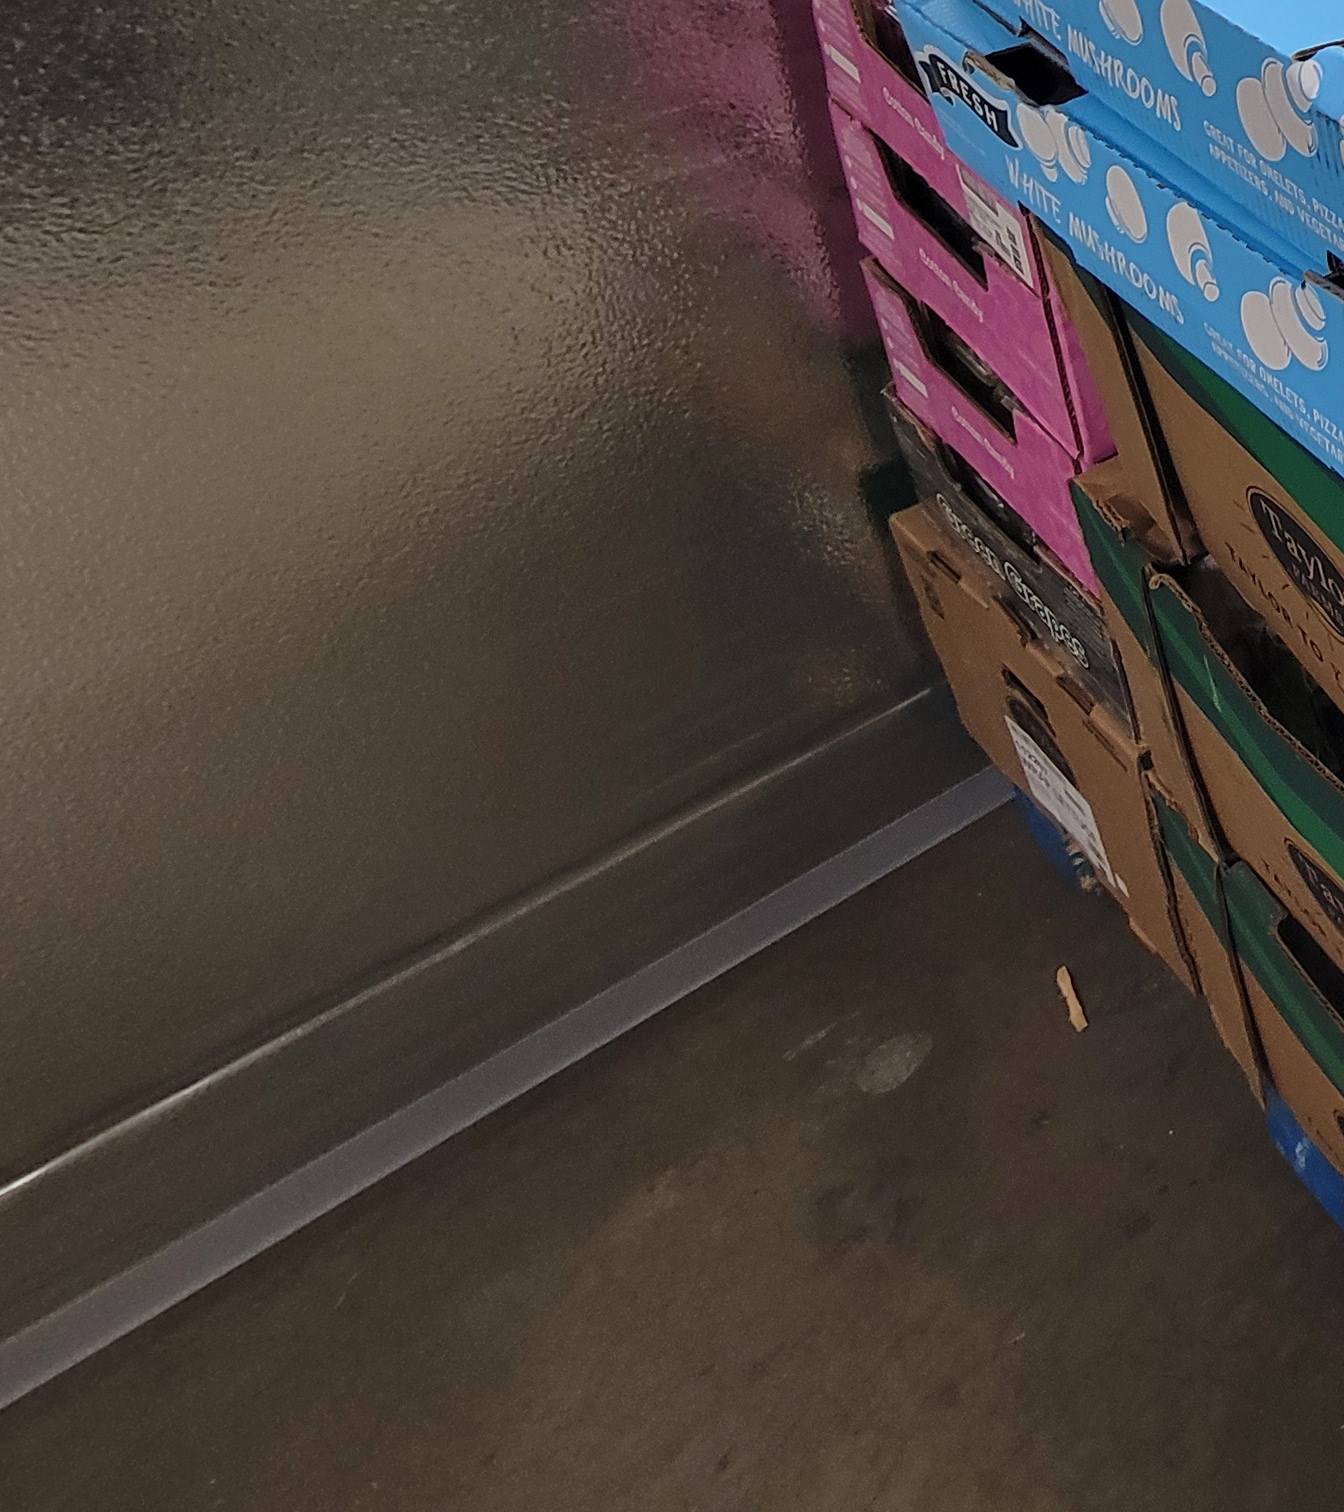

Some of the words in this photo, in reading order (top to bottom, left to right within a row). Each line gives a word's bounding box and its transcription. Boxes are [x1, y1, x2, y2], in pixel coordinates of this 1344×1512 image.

[937, 62, 998, 133] FRESH
[1067, 24, 1182, 131] MUSHROOMS
[1203, 120, 1235, 153] GREAT
[1236, 142, 1258, 171] FOR
[1273, 190, 1296, 216] AND
[1005, 154, 1062, 224] WHITE
[1068, 212, 1185, 325] MUSHROOMS
[1236, 343, 1258, 377] FOR
[1297, 624, 1326, 664] TO
